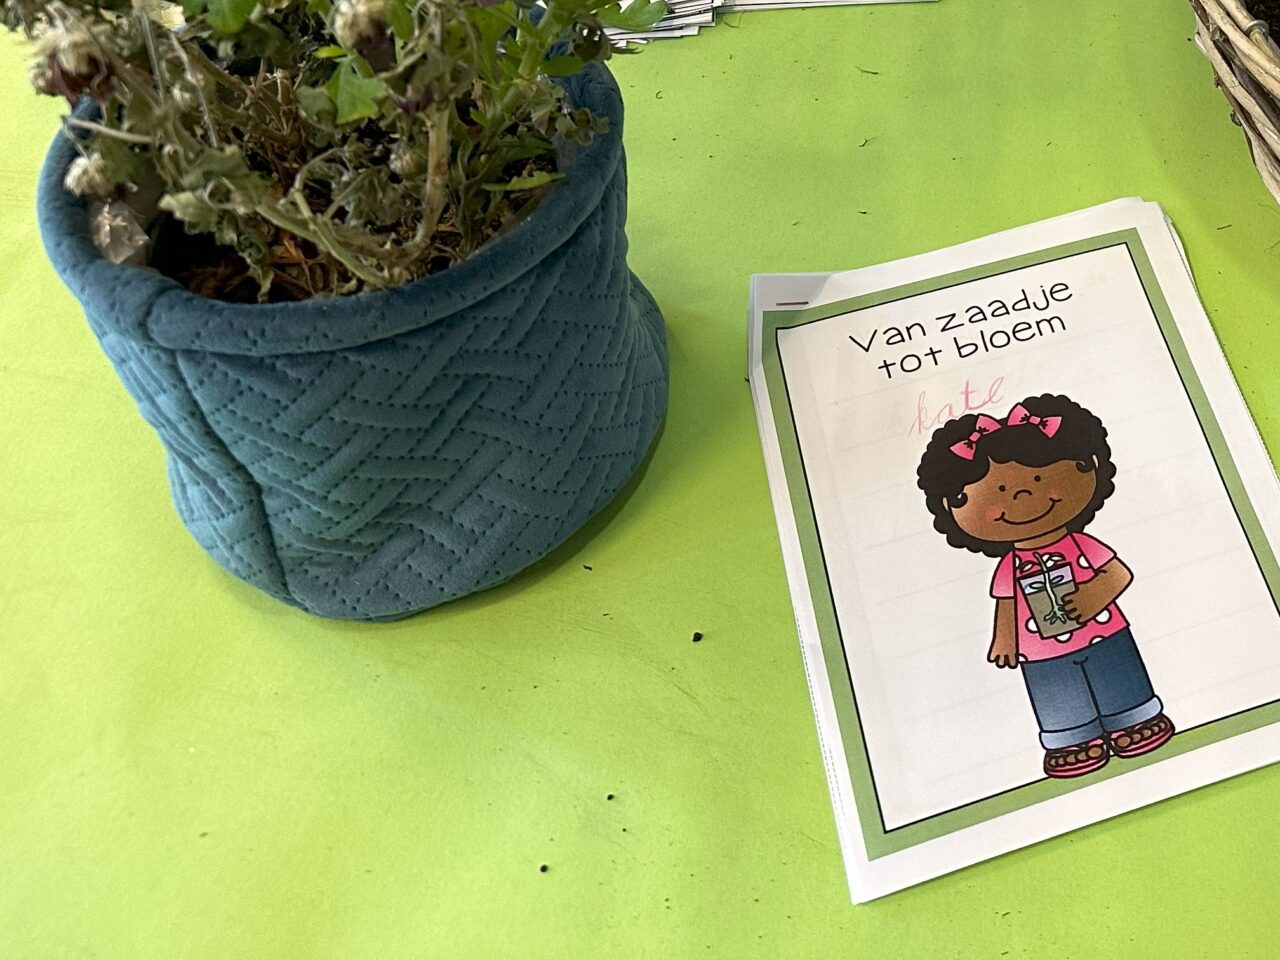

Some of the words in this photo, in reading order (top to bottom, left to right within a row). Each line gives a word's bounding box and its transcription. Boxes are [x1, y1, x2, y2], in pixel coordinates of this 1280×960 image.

[848, 322, 927, 353] Van
[935, 281, 1073, 333] zaadje
[877, 335, 943, 379] tot
[953, 314, 1067, 359] bloem
